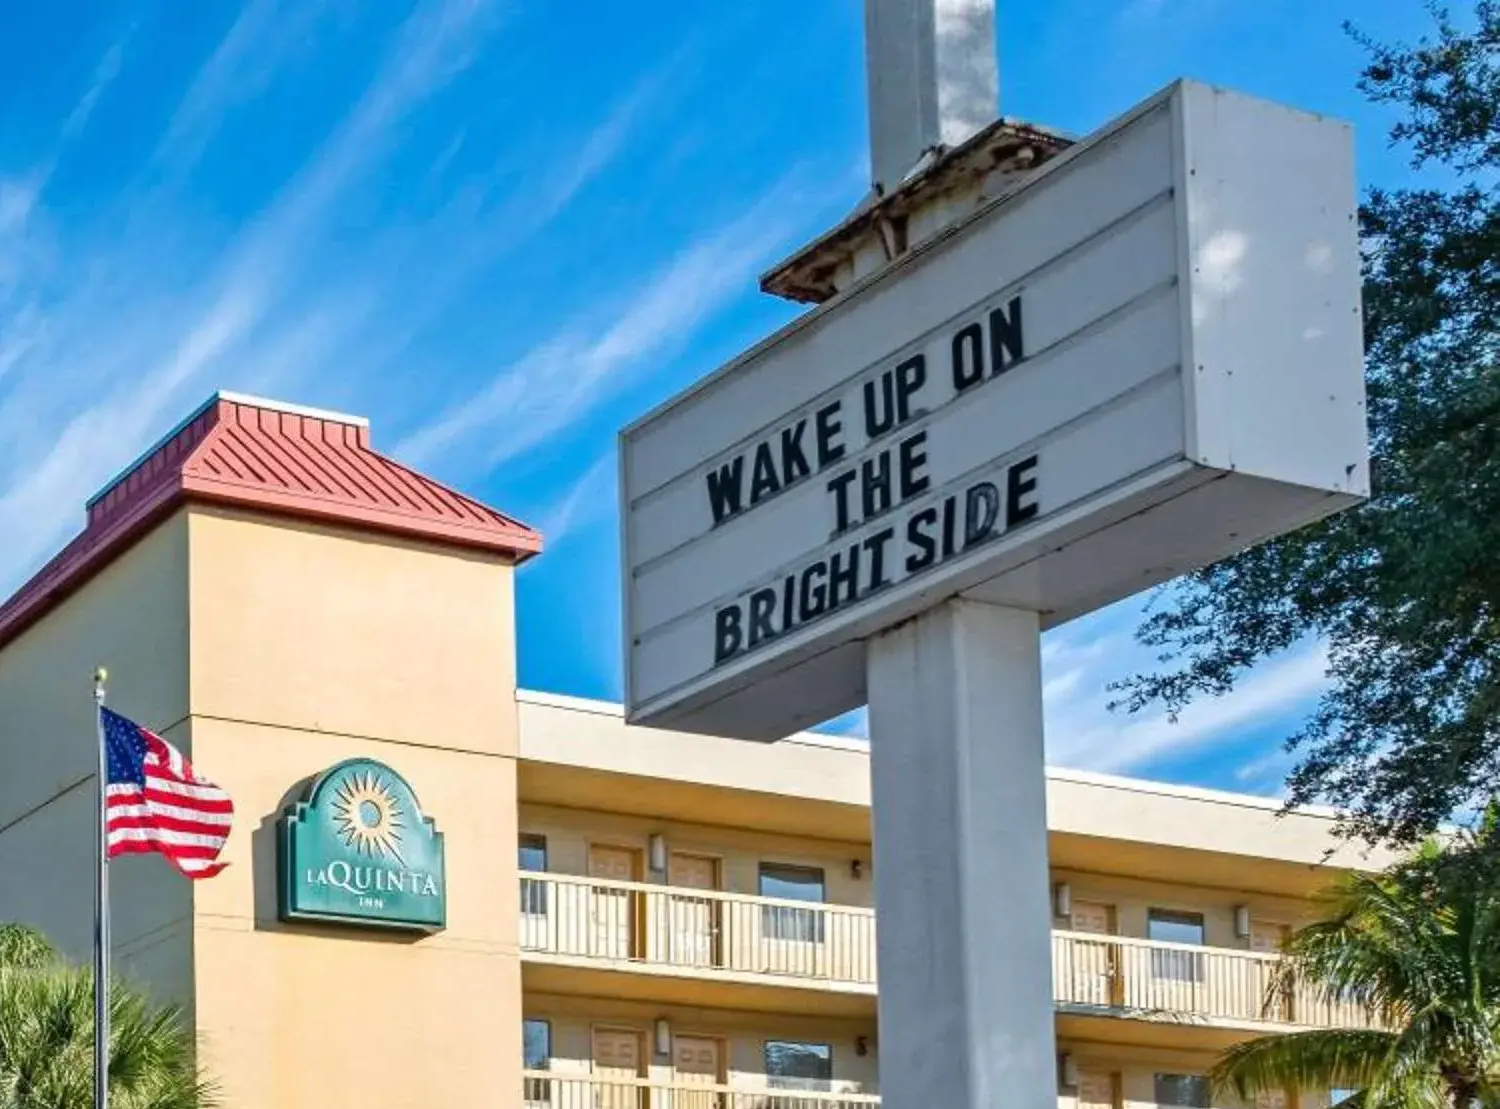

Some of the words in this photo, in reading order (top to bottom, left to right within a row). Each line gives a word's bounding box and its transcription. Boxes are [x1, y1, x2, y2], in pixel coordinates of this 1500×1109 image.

[707, 401, 845, 524] WAKE
[863, 353, 926, 440] UP
[951, 295, 1024, 392] ON
[827, 430, 931, 533] THE
[714, 527, 893, 665] BRIGHT
[905, 455, 1039, 574] SIDE
[359, 897, 383, 909] INN
